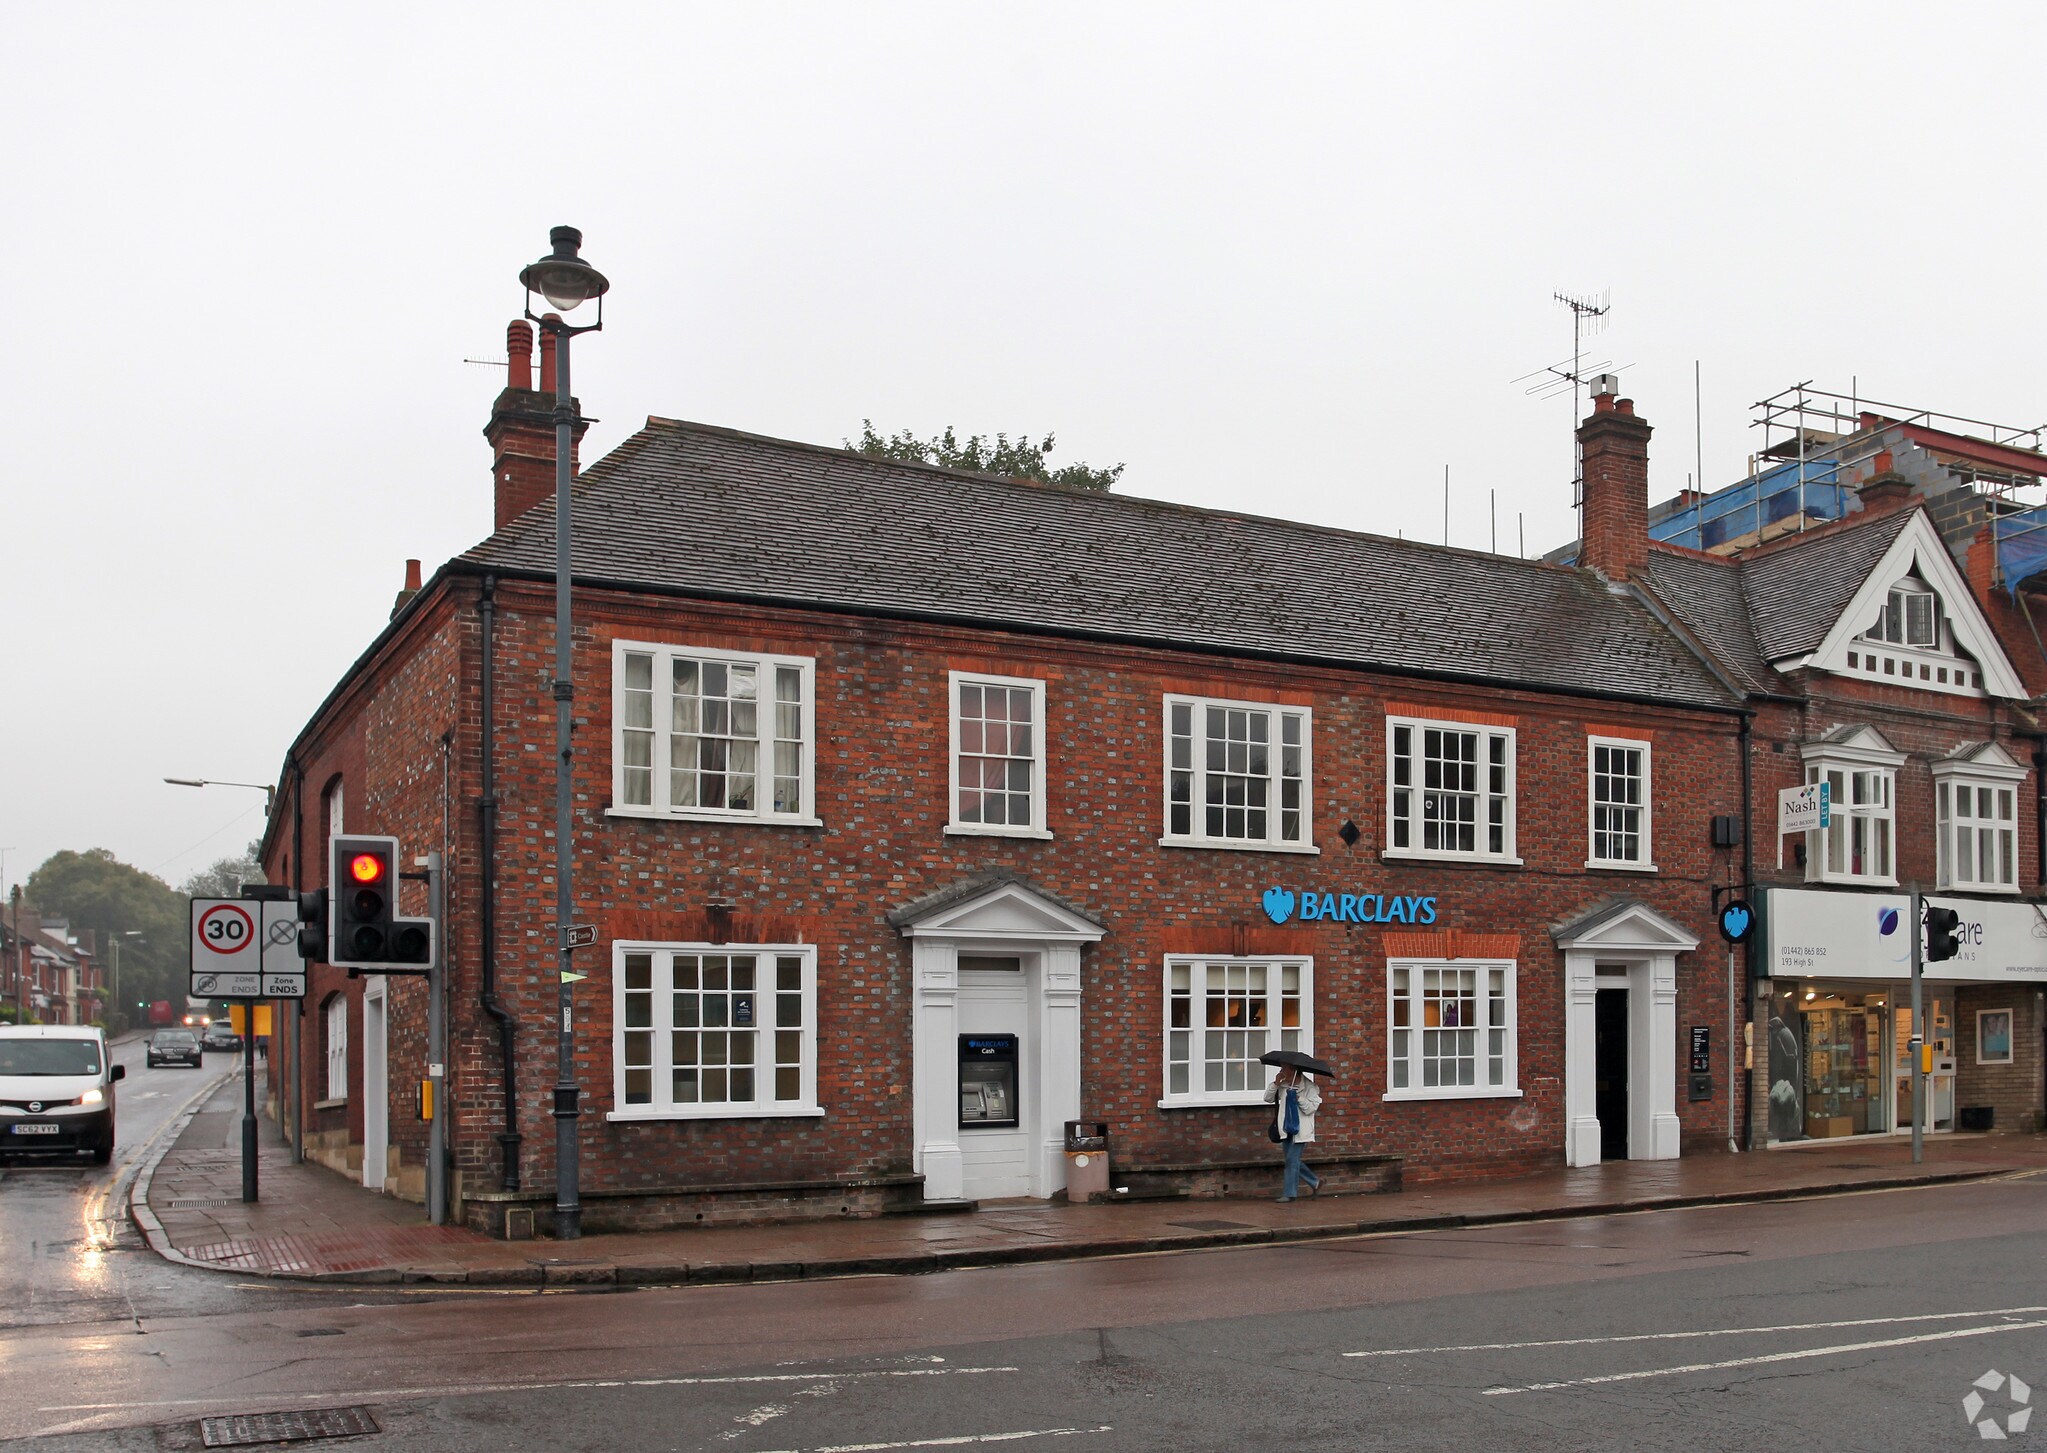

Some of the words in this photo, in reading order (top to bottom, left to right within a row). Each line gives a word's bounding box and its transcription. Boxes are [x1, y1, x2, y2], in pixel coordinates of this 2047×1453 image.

[1821, 792, 1828, 803] BY
[1785, 797, 1816, 815] Nash
[1299, 891, 1437, 924] BARCLAYS
[207, 919, 244, 940] 30
[1781, 946, 1803, 956] (01442)
[1804, 947, 1815, 956] 865
[1816, 947, 1827, 956] 852
[1781, 957, 1792, 967] 193
[1793, 958, 1807, 968] High
[1807, 958, 1814, 967] St
[269, 986, 298, 994] ENDS
[976, 1040, 1009, 1048] BARCLAYS
[16, 1124, 39, 1133] SC62
[41, 1124, 58, 1133] VYX
